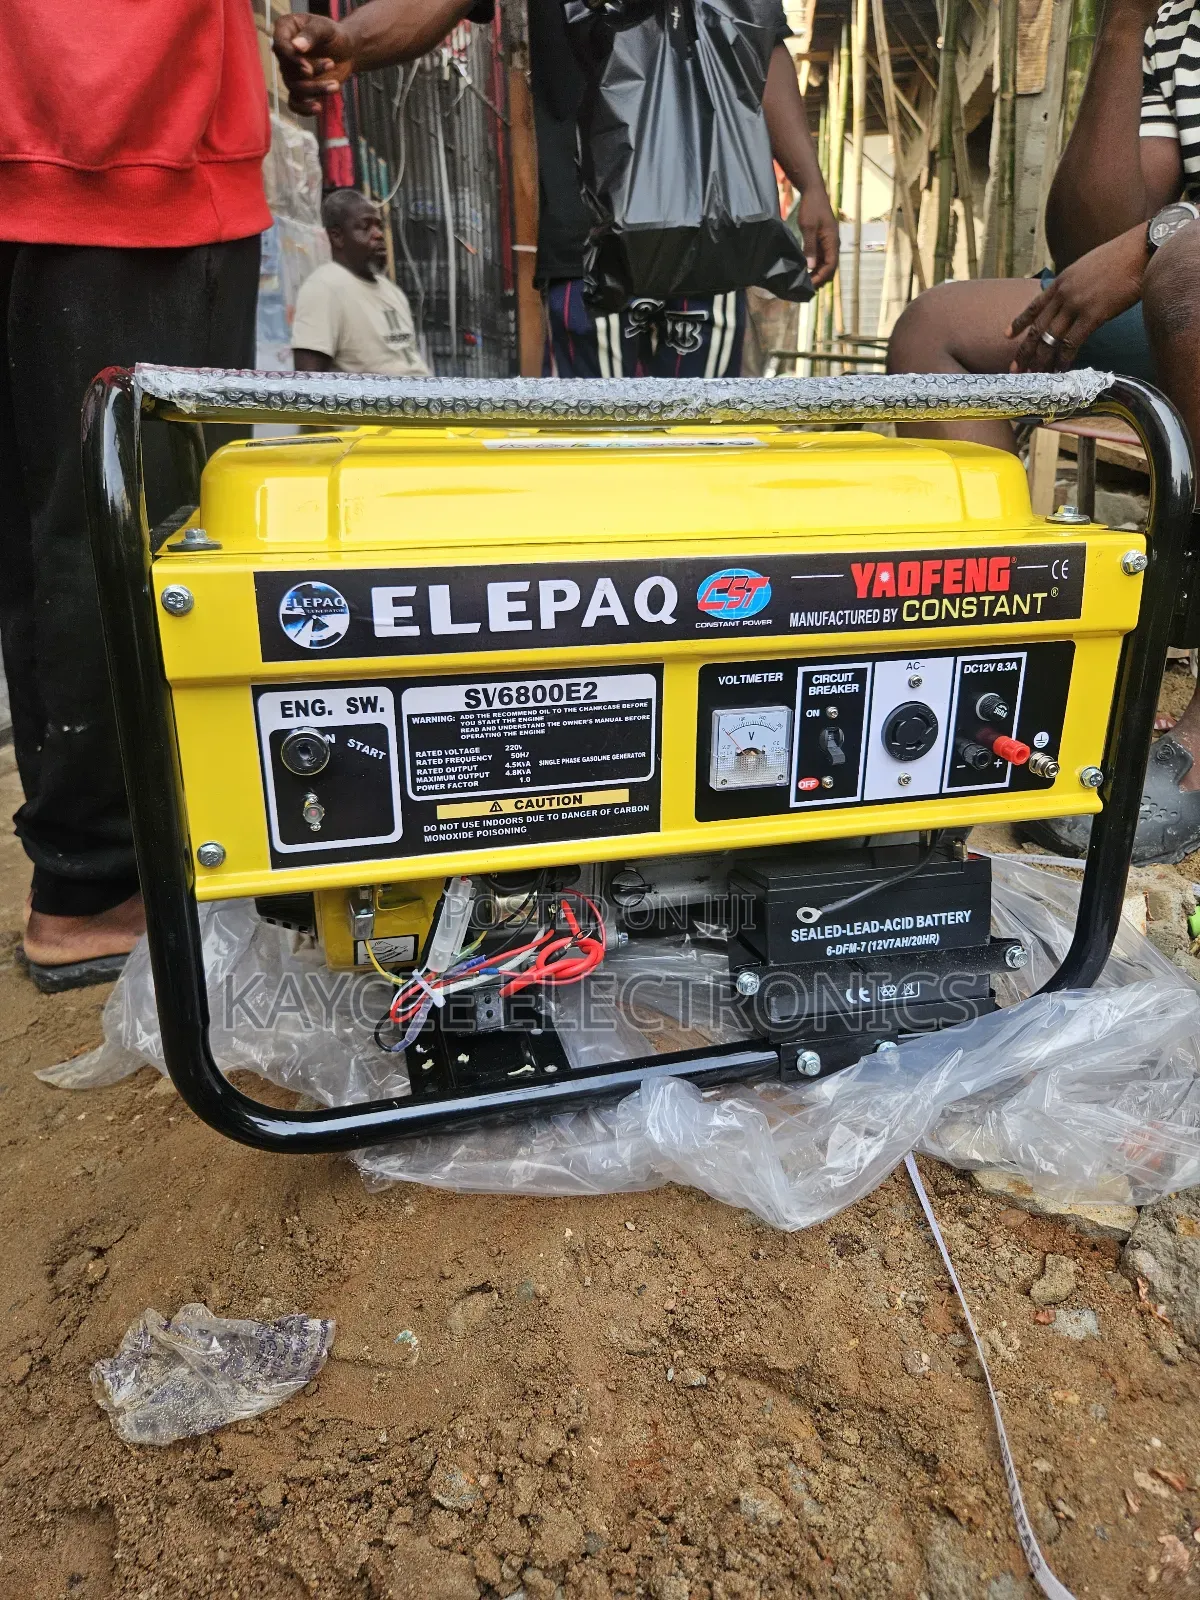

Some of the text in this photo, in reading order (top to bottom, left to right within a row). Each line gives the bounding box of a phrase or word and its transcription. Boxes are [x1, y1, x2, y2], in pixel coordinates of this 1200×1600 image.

[850, 556, 1011, 599] YAOFENG
[697, 576, 771, 612] CST
[286, 597, 345, 608] ELEPAQ
[371, 575, 678, 638] ELEPAQ
[790, 592, 1048, 628] MANUFACTURED BY CONSTANT
[696, 621, 742, 629] CONSTANT
[964, 662, 1018, 673] DC12V 8.3A
[718, 672, 784, 685] VOLTMETER
[812, 672, 854, 684] CIRCUIT
[464, 681, 598, 709] SV6800E2
[808, 684, 859, 696] BREAKER
[280, 696, 384, 718] ENG. SW.
[412, 715, 456, 724] WARNING:
[806, 709, 820, 718] ON
[748, 732, 755, 740] V
[346, 738, 386, 760] START
[445, 747, 480, 755] VOLTAGE
[416, 758, 443, 766] RATED
[445, 754, 492, 764] FREQUENCY
[581, 754, 610, 763] GASOLINE
[611, 752, 646, 760] GENERATOR
[446, 765, 478, 773] OUTPUT
[416, 774, 455, 784] MAXIMUM
[458, 772, 490, 780] OUTPUT
[447, 781, 479, 789] FACTOR
[798, 780, 816, 789] OFF
[514, 794, 582, 810] CAUTION
[440, 822, 459, 831] NOT
[462, 821, 480, 829] USE
[483, 816, 523, 826] INDOORS
[561, 810, 598, 819] DANGER
[614, 805, 650, 814] CARBON
[424, 826, 527, 842] MONOXIDE POISONING
[791, 909, 972, 942] SEALED-LEAD-ACID BATTERY
[826, 933, 940, 957] 6-DFM-7 (12V7AH/20HR)
